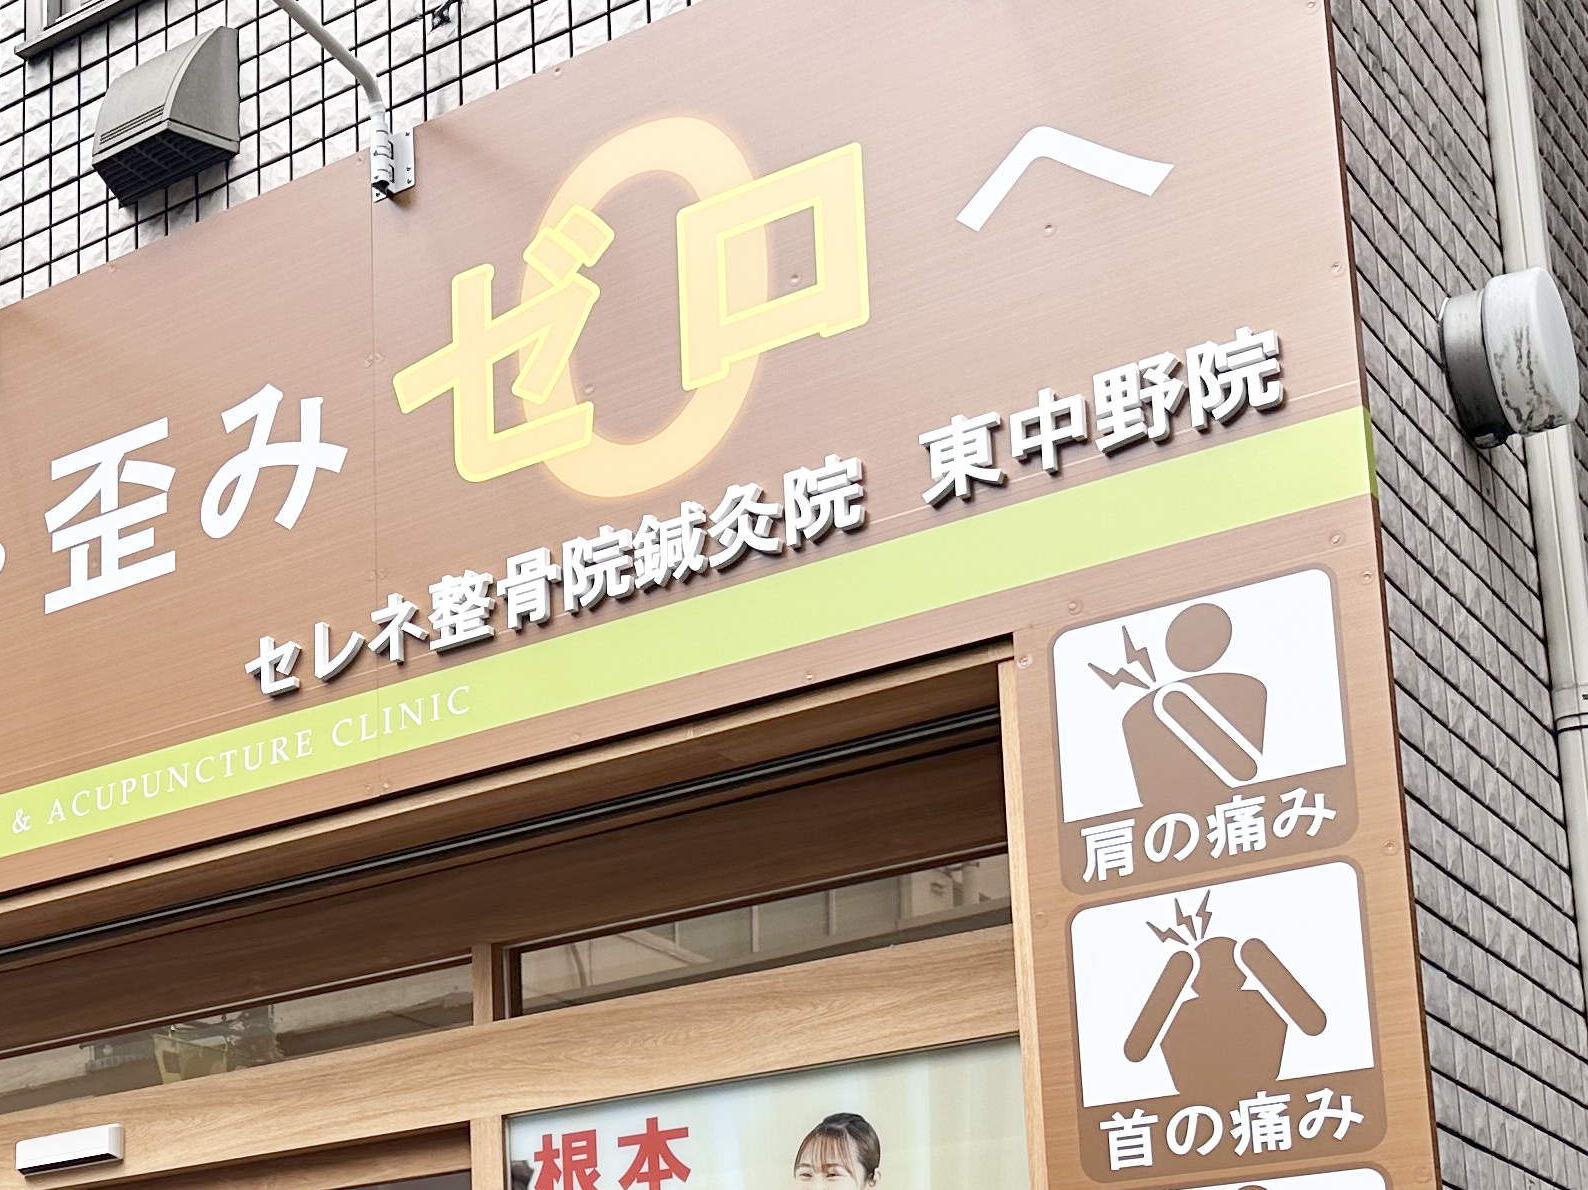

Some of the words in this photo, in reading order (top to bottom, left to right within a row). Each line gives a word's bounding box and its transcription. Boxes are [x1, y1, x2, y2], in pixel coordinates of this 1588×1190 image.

[391, 141, 871, 482] ゼロ
[955, 123, 1175, 232] へ
[244, 453, 867, 699] セレネ整骨院鍼灸院
[919, 325, 1287, 506] 東中野院
[11, 807, 32, 834] &
[48, 728, 314, 825] ACUPUNCTURE
[330, 685, 472, 748] CLINIC
[1080, 786, 1338, 884] 肩の痛み
[1099, 1087, 1365, 1171] 首の痛み
